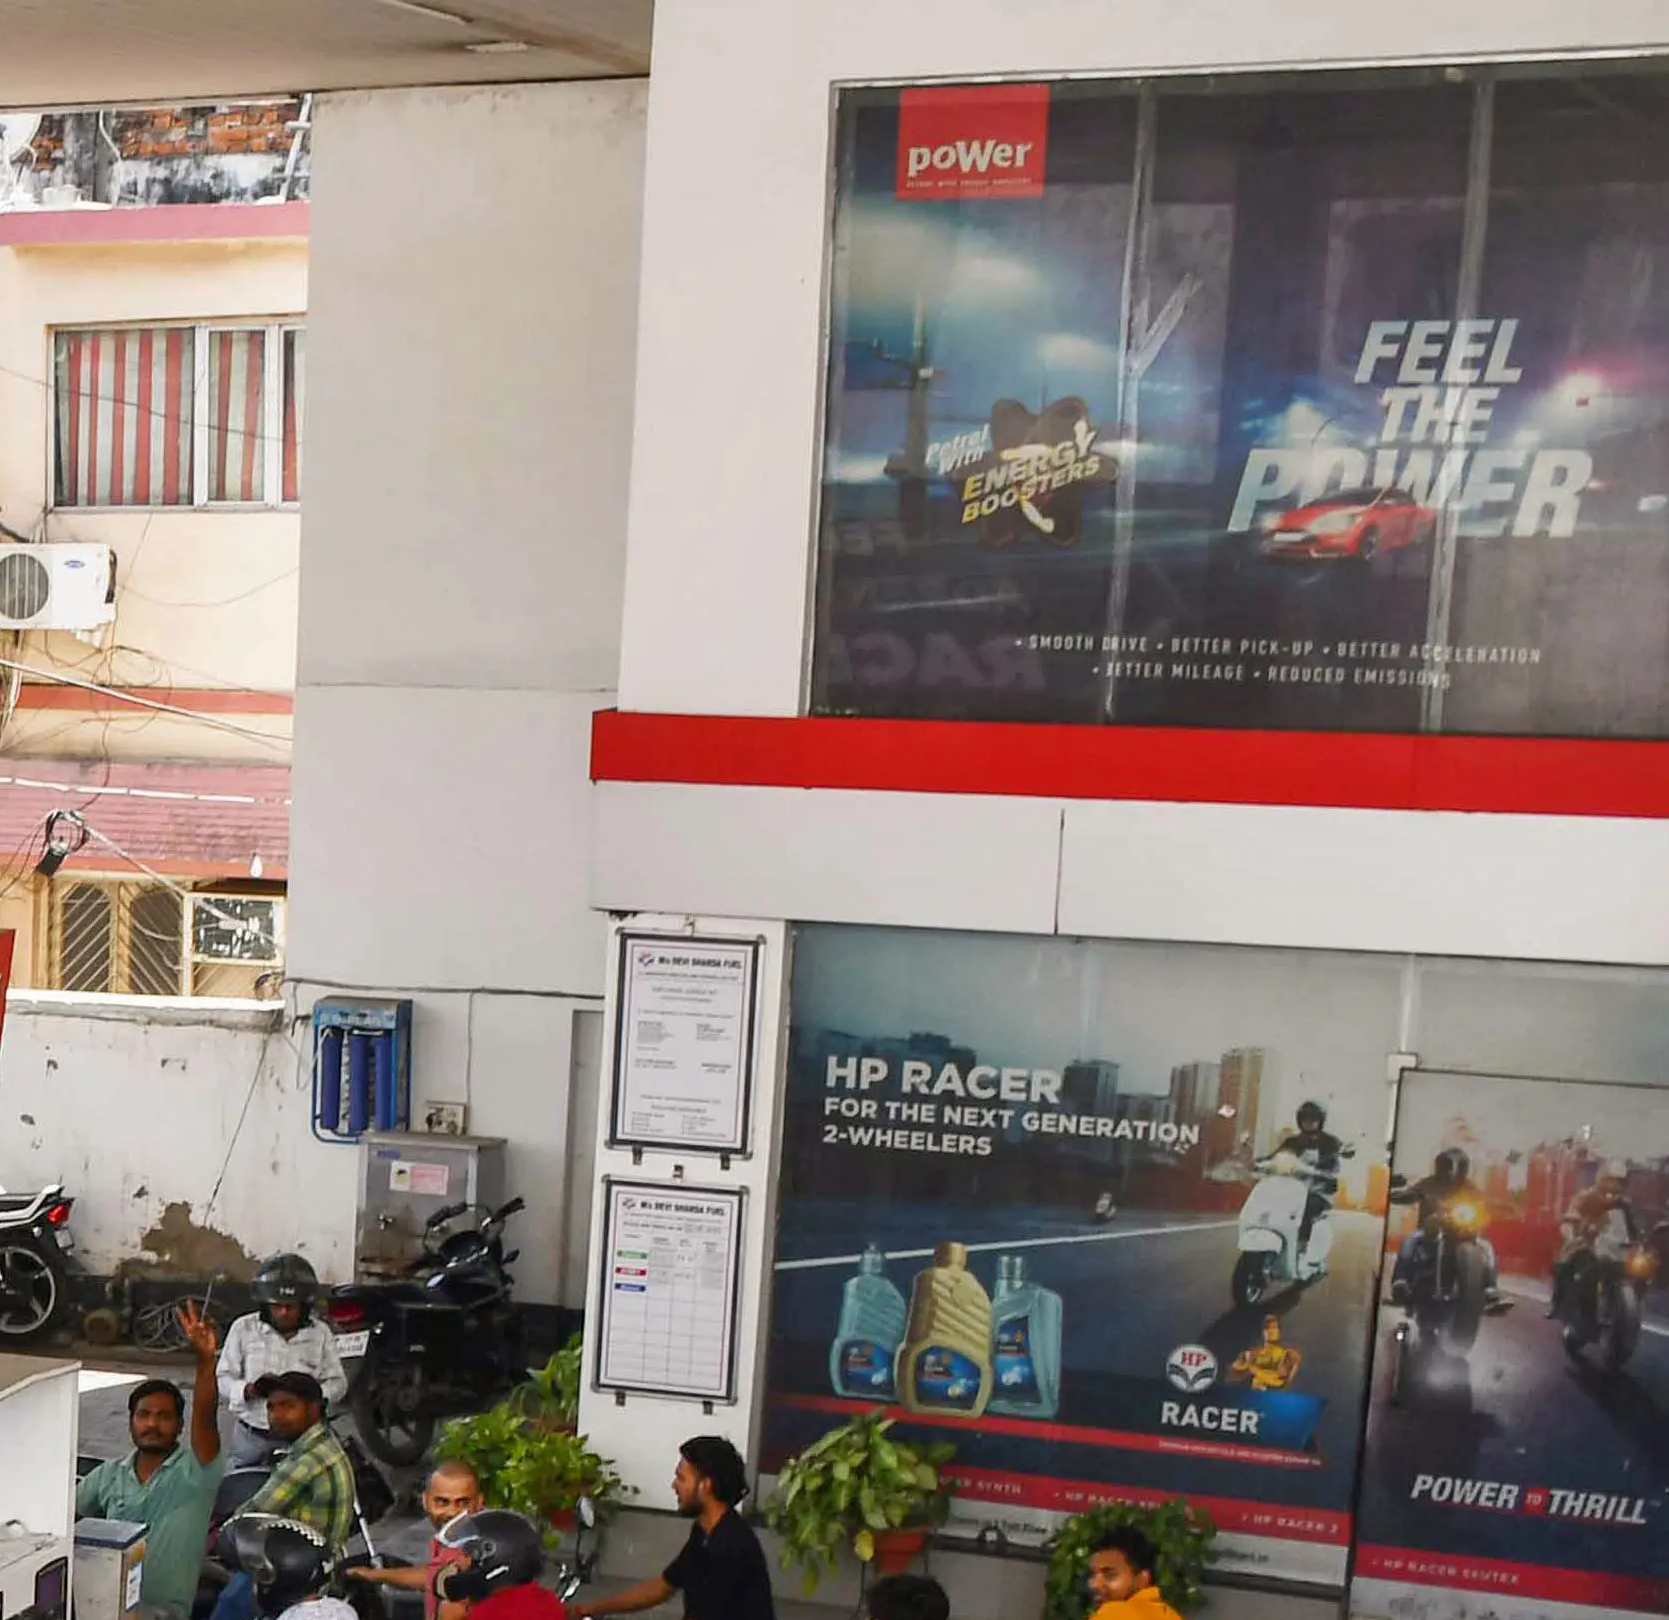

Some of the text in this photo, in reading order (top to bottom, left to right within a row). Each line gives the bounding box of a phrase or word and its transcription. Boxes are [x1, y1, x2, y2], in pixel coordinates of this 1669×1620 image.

[1355, 317, 1523, 385] FEEL
[1379, 385, 1495, 443] THE
[963, 420, 1097, 503] ENERGY
[961, 453, 1101, 524] BOOSTERS
[1226, 447, 1593, 540] POWER
[1028, 634, 1541, 665] SMOOTH DRIVE BETTER PICK-UP BETTER ACCELERATION
[1171, 664, 1245, 682] MILEAGE
[1267, 666, 1345, 685] REDUCED
[1353, 669, 1451, 691] EMISSIONS
[826, 1056, 1063, 1104] HP RACER
[823, 1123, 994, 1158] 2-WHEELERS
[824, 1097, 1201, 1146] FOR THE NEXT GENERATION
[1181, 1351, 1209, 1368] HP
[1161, 1402, 1259, 1435] RACER
[1410, 1474, 1519, 1510] POWER
[1549, 1488, 1648, 1525] THRILL
